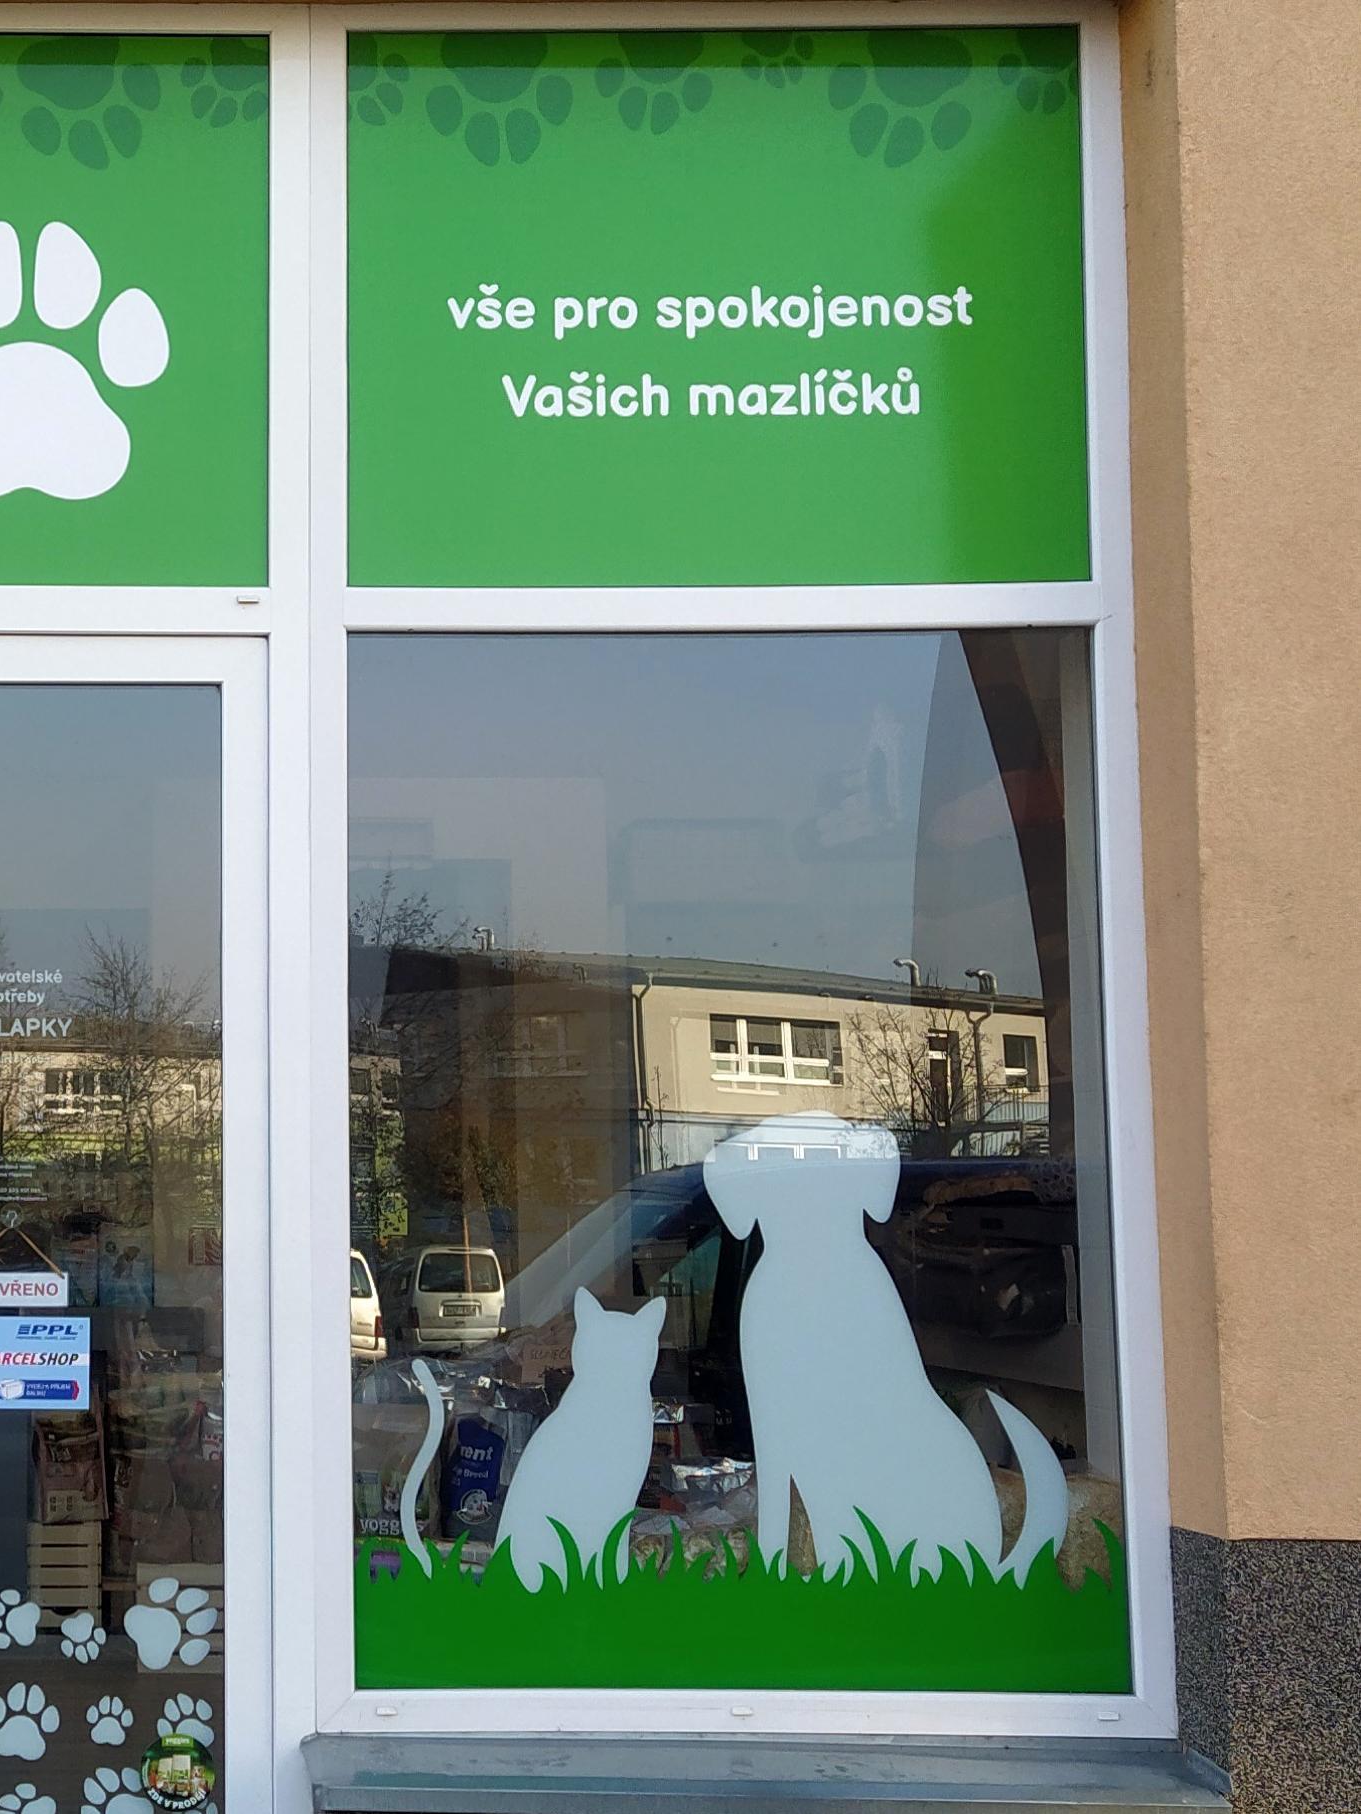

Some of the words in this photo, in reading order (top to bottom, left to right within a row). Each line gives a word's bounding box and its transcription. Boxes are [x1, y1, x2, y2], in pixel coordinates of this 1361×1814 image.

[447, 283, 536, 329] vše
[554, 296, 638, 340] pro
[656, 284, 973, 339] spokojenost
[501, 371, 669, 417] Vašich
[689, 367, 920, 416] mazlíčků
[31, 1324, 79, 1336] PPL
